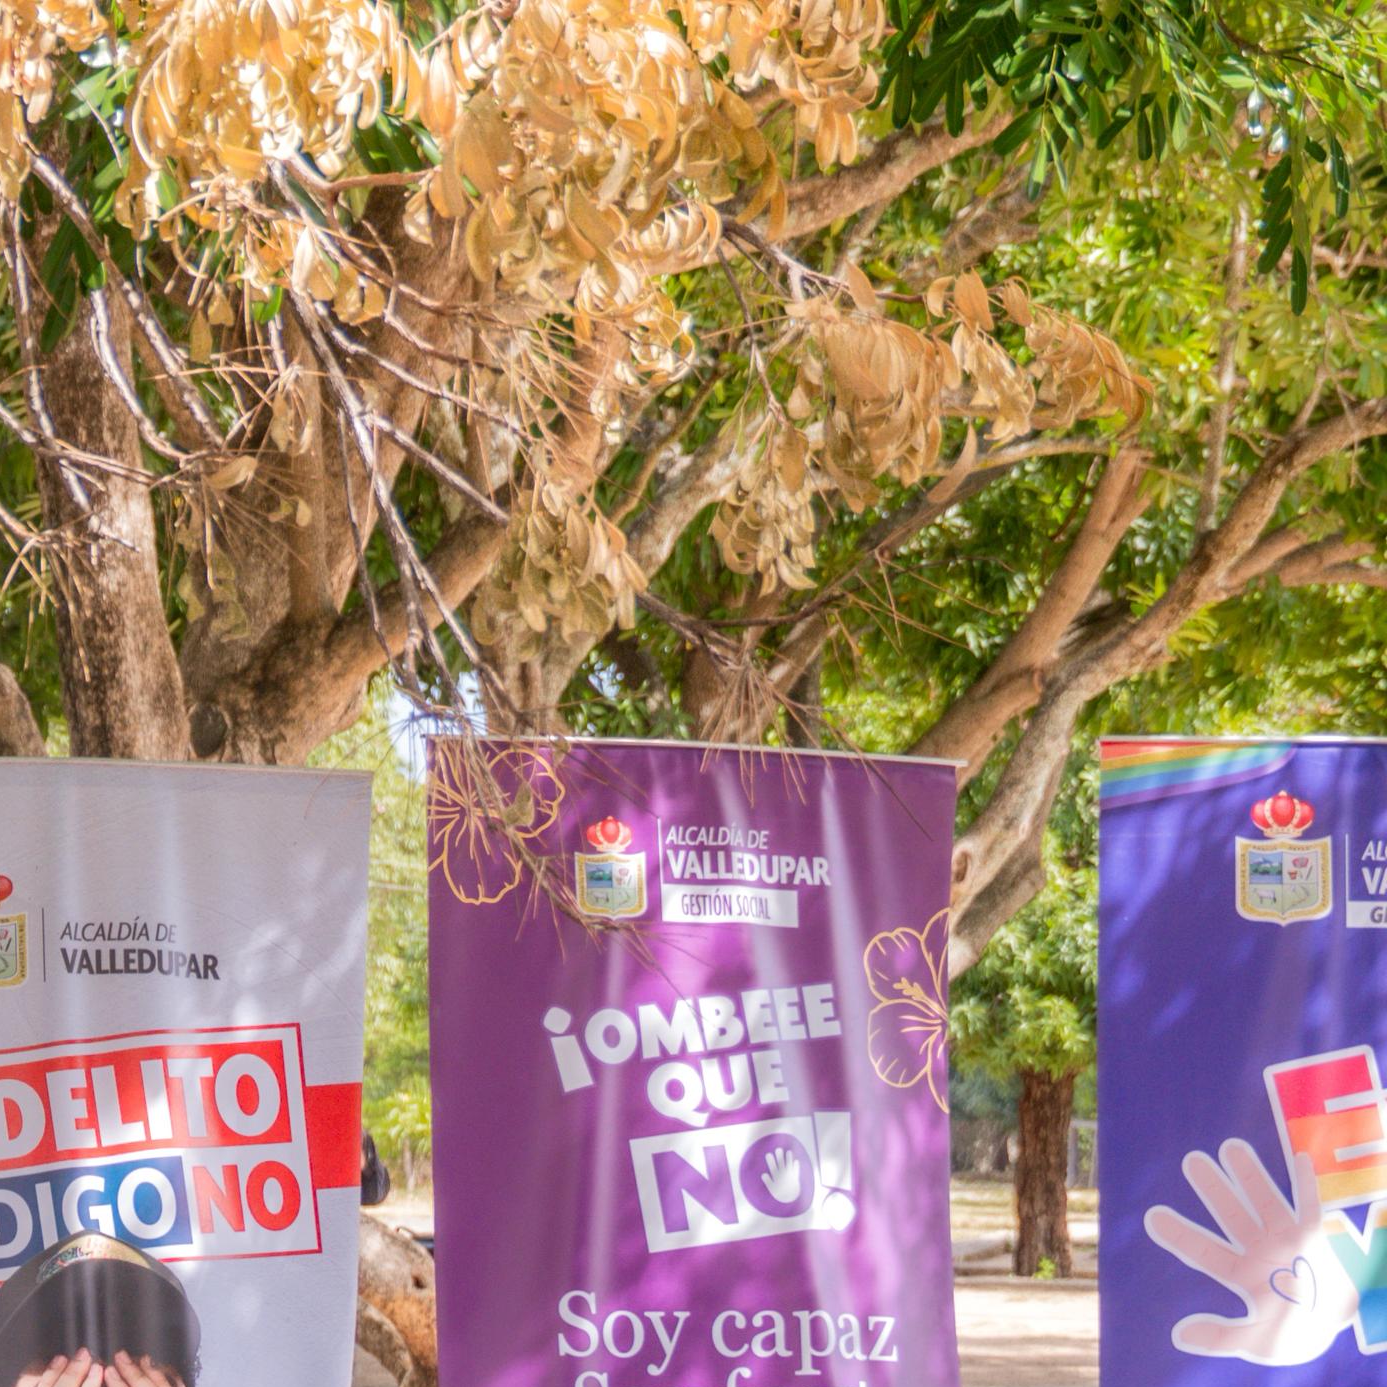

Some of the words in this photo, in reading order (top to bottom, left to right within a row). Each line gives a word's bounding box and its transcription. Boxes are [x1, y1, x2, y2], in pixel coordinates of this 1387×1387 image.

[666, 824, 744, 849] ALCALDÍA
[747, 830, 770, 850] DE
[666, 850, 831, 887] VALLEDUPAR
[681, 888, 732, 916] GESTIÓN
[736, 894, 771, 920] SOCIAL
[60, 915, 150, 943] ALCALDÍA
[155, 923, 177, 943] DE
[60, 947, 220, 981] VALLEDUPAR
[543, 983, 842, 1093] ¡OMBEEE
[647, 1048, 790, 1127] QUE
[191, 1160, 302, 1235] NO
[557, 1290, 690, 1376] Soy
[712, 1306, 899, 1376] capaz
